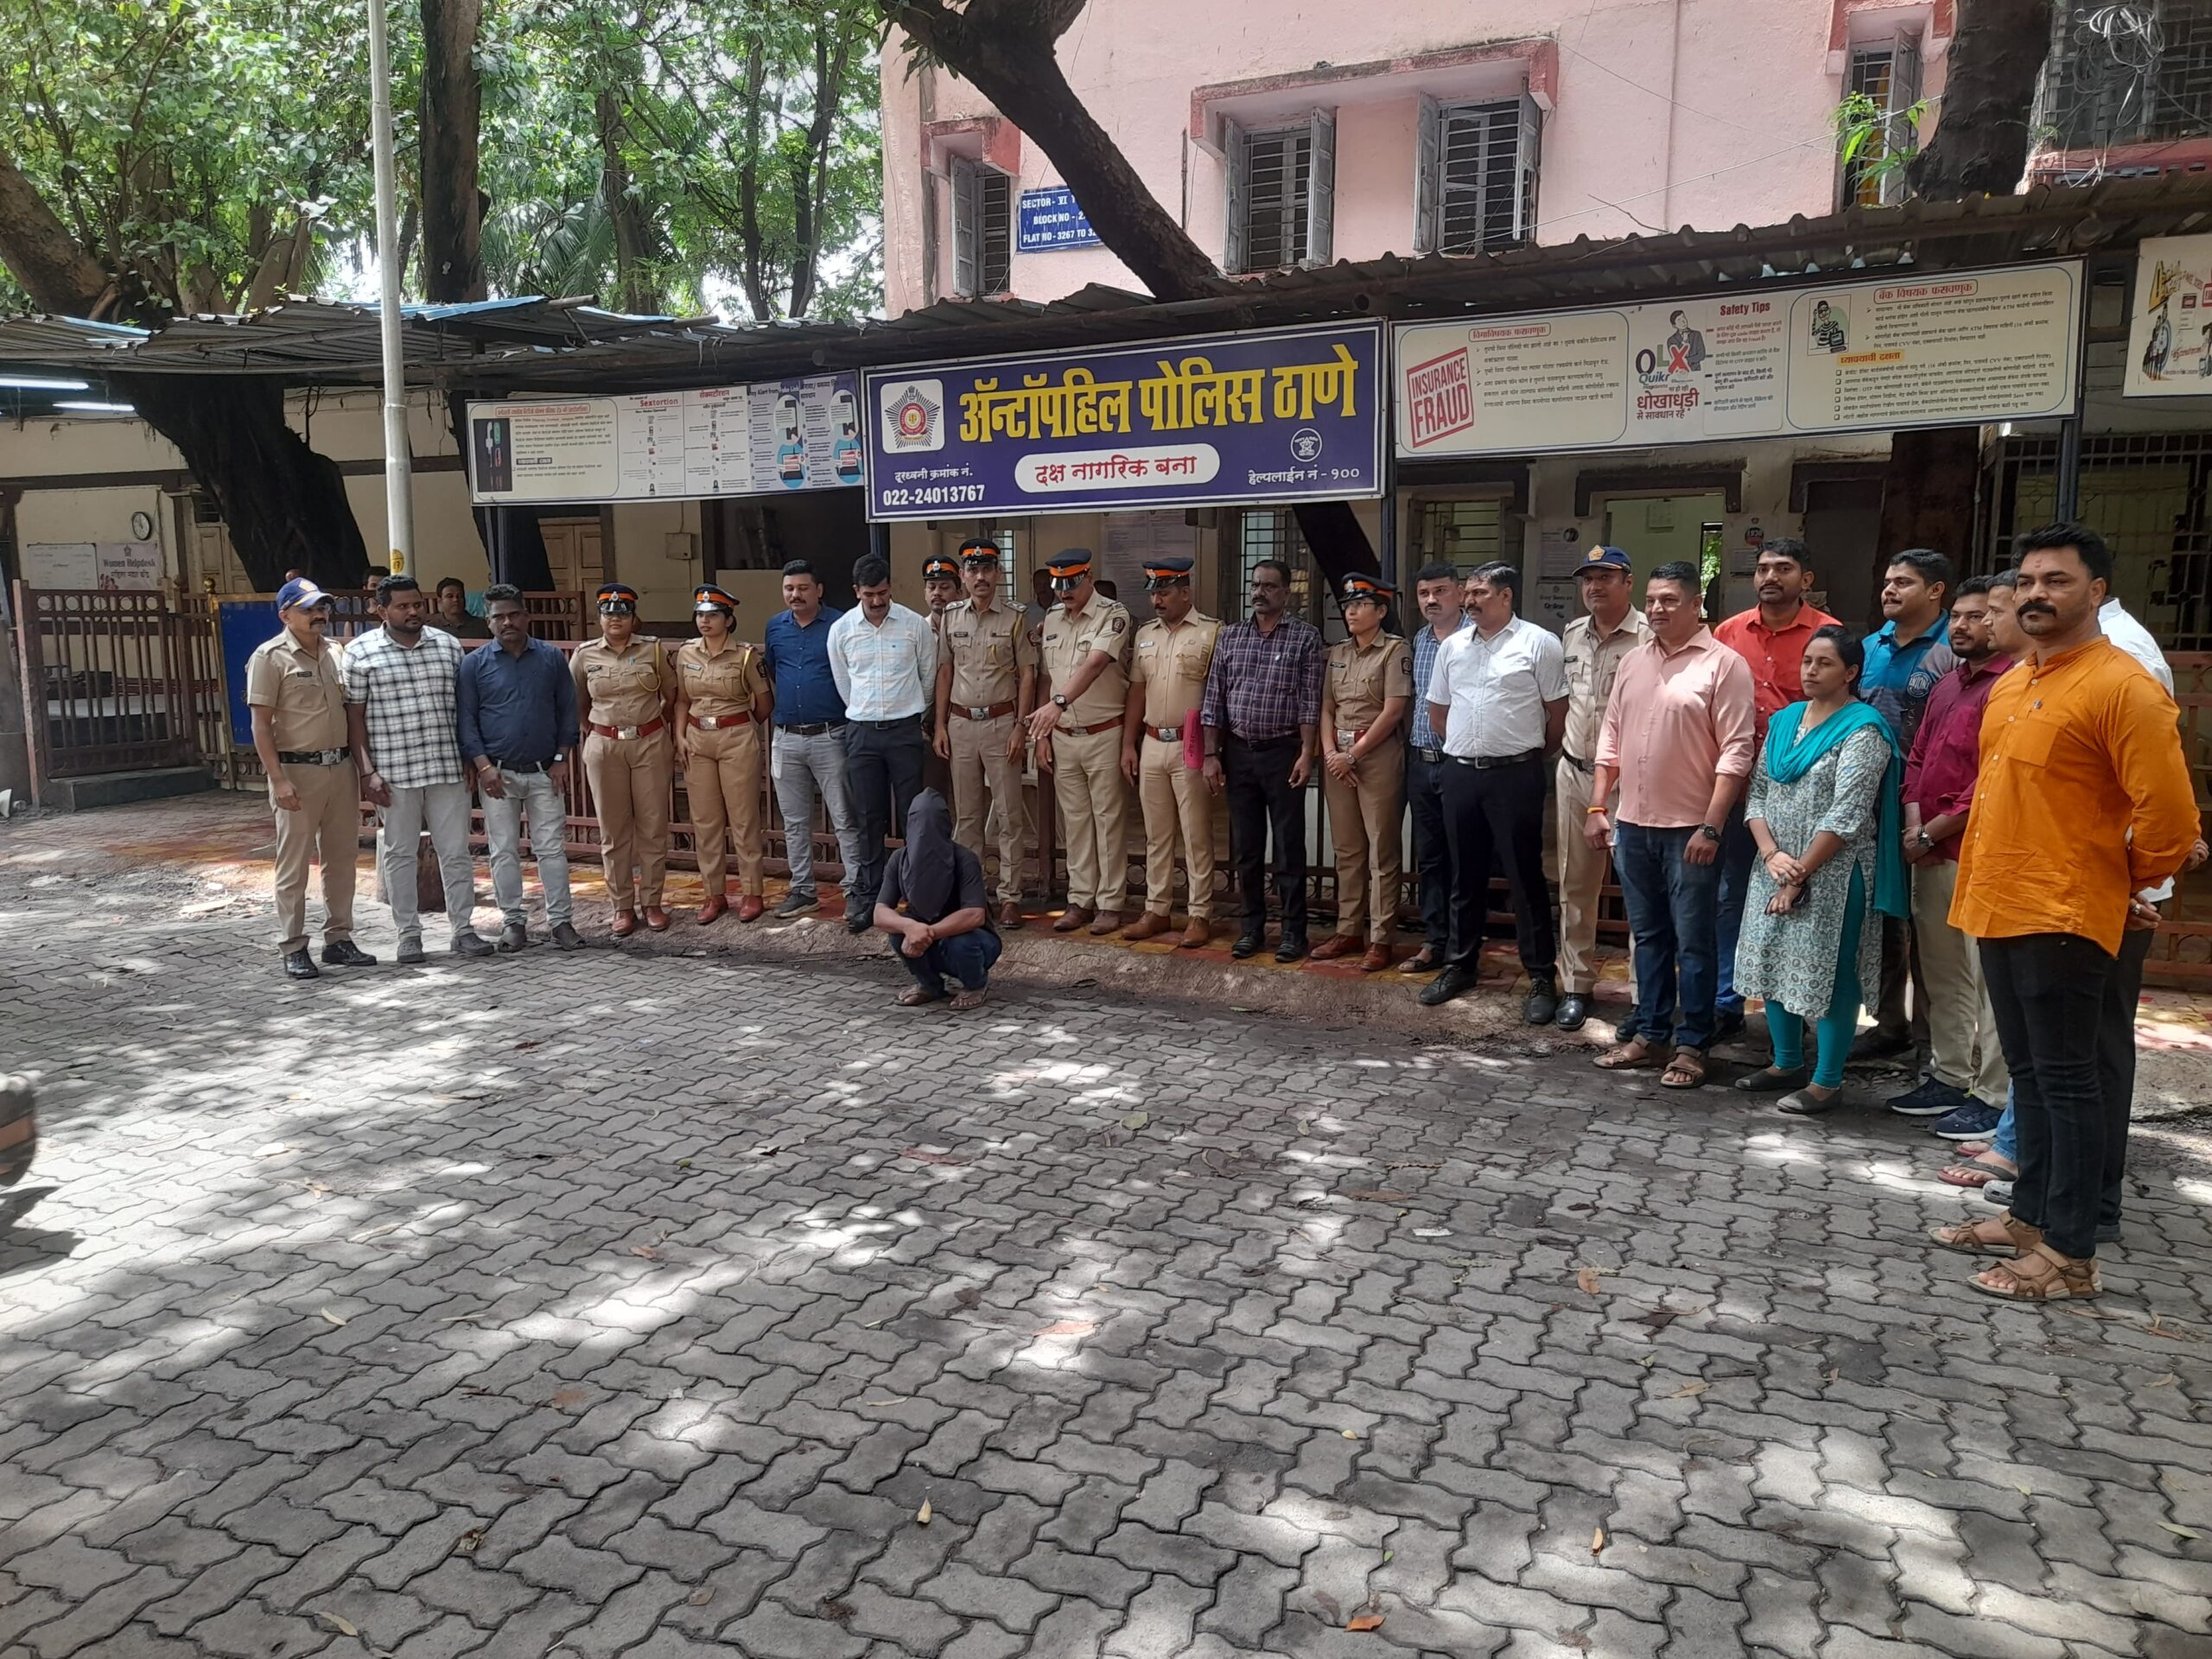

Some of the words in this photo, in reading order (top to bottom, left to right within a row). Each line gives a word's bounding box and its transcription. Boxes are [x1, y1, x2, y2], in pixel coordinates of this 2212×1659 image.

[1033, 214, 1057, 225] BLOCK
[1058, 213, 1070, 222] NO
[1078, 211, 1085, 220] 2
[1023, 232, 1039, 243] FLAT
[1041, 232, 1052, 241] NO
[1057, 230, 1075, 240] 3267
[1077, 228, 1086, 238] TO
[1719, 304, 1750, 316] Safety
[1751, 302, 1771, 314] Tips
[1636, 344, 1690, 374] OLX
[1139, 355, 1265, 431] पोलिस
[1271, 343, 1360, 419] ठाणे
[1411, 357, 1467, 399] INSURANCE
[1638, 371, 1670, 386] Quikr
[639, 397, 678, 408] Sextortion
[1414, 384, 1470, 438] FRAUD
[1637, 410, 1643, 420] से
[1645, 410, 1675, 420] सावधान
[894, 467, 928, 484] दूरध्वनी
[930, 463, 959, 481] क्रमांक
[1035, 462, 1065, 486] दक्ष
[1070, 454, 1149, 481] नागरिक
[1153, 454, 1197, 478] बना
[1248, 466, 1305, 485] हेल्पलाईन
[1307, 464, 1319, 480] नं
[883, 484, 985, 506] 022-24013767
